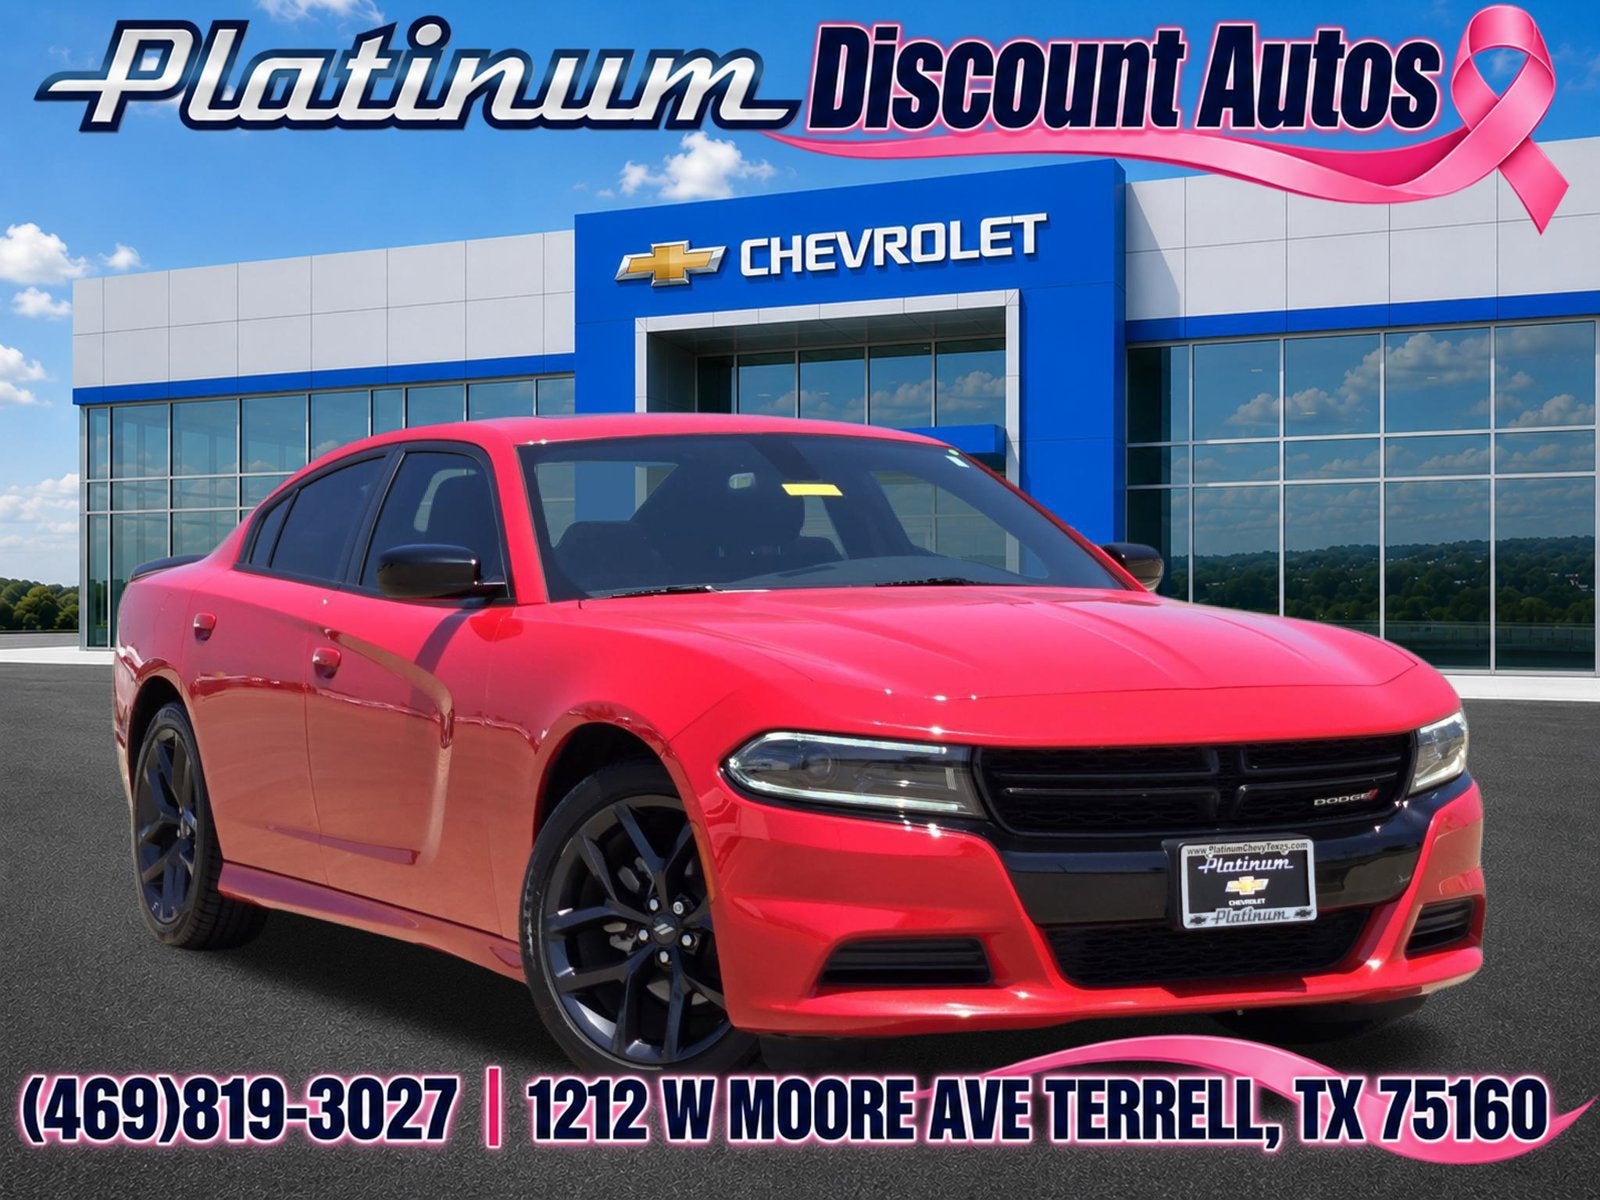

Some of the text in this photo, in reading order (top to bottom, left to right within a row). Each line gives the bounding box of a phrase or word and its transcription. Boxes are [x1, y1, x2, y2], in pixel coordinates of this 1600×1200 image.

[739, 212, 1048, 277] CHEVROLET
[1313, 792, 1370, 806] DODGE
[1187, 842, 1308, 855] www.PlatinumChevyTexas.com
[1198, 856, 1294, 874] Platinum
[1228, 898, 1266, 906] CHEVROLET
[1211, 907, 1289, 925] Platinum
